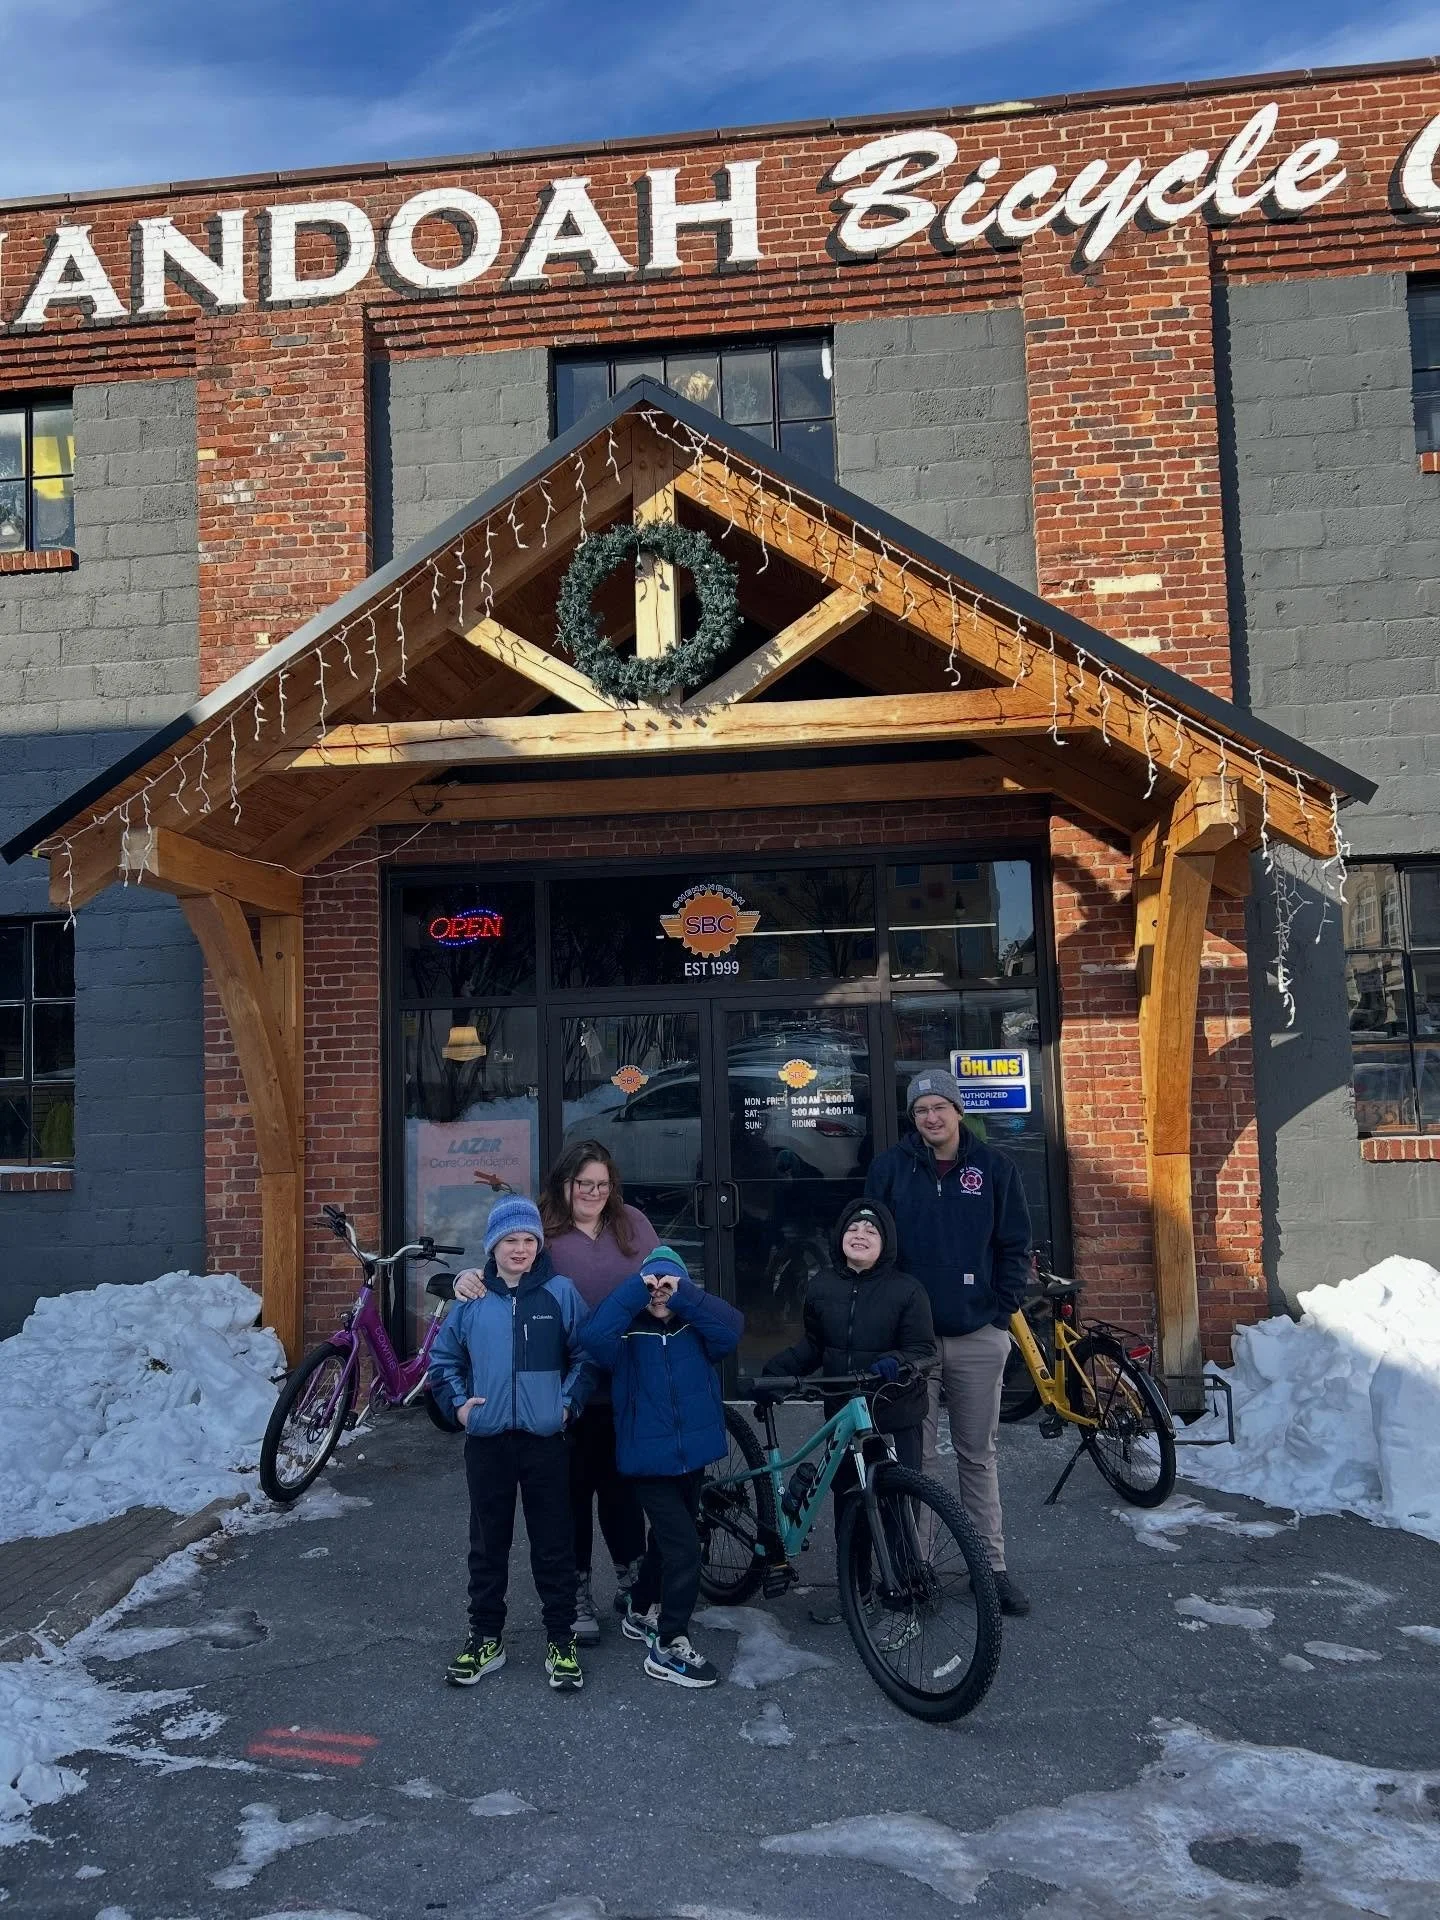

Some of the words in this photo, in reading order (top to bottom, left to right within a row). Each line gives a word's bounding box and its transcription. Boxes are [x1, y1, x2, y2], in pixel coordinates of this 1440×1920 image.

[0, 158, 765, 326] ANDOAH
[831, 102, 1347, 263] Bicycle
[429, 916, 503, 939] OPEN
[685, 914, 735, 936] SBC
[684, 962, 708, 977] EST
[711, 961, 740, 975] 1999
[960, 1056, 1020, 1077] ÖHLINS
[621, 1077, 639, 1085] SBC
[744, 1097, 761, 1106] MON
[808, 1096, 820, 1104] AM
[960, 1091, 1009, 1100] AUTHORIZED
[744, 1109, 760, 1118] SAT:
[791, 1108, 807, 1116] 9:00
[808, 1107, 820, 1116] AM
[825, 1107, 841, 1115] 4:00
[842, 1106, 854, 1115] PM
[744, 1121, 762, 1130] SUN:
[791, 1119, 817, 1128] RIDING
[447, 1136, 503, 1155] LAZER
